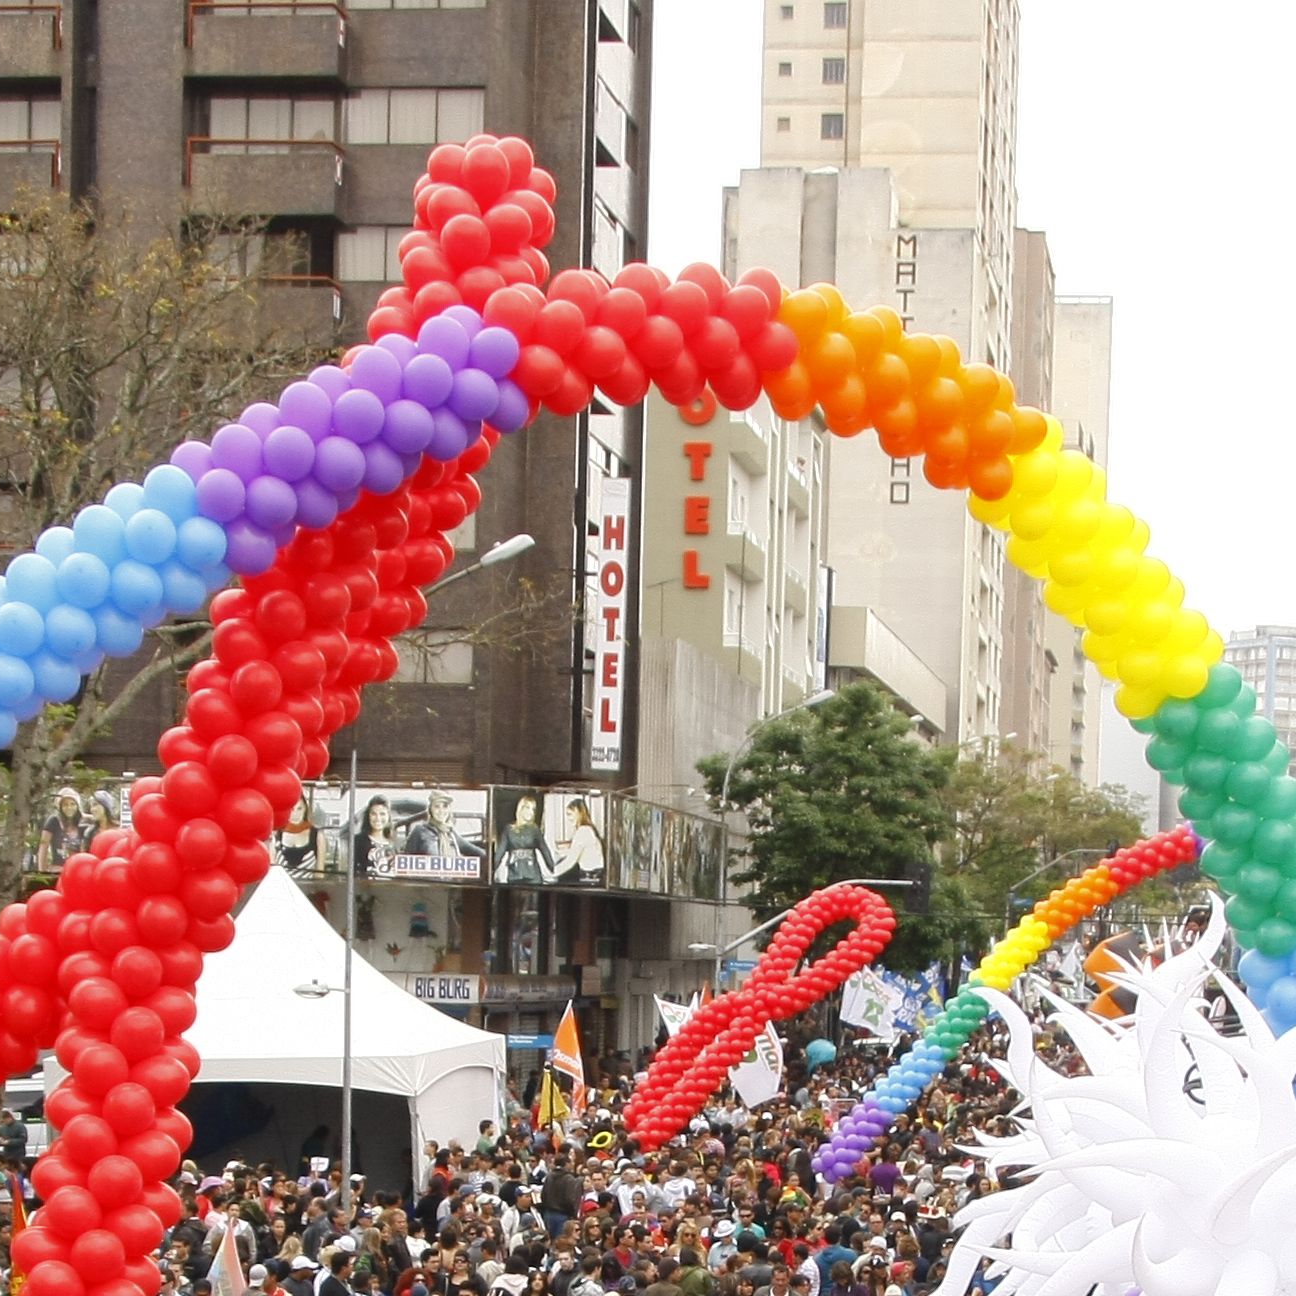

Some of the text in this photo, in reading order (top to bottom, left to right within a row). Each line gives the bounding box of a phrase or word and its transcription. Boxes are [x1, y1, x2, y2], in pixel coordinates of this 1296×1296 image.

[890, 235, 917, 504] MATTHO
[679, 387, 717, 590] OTEL
[599, 515, 625, 733] HOTEL
[397, 856, 479, 872] BIG BURG
[415, 977, 435, 999] BIG
[438, 977, 471, 1000] BURG
